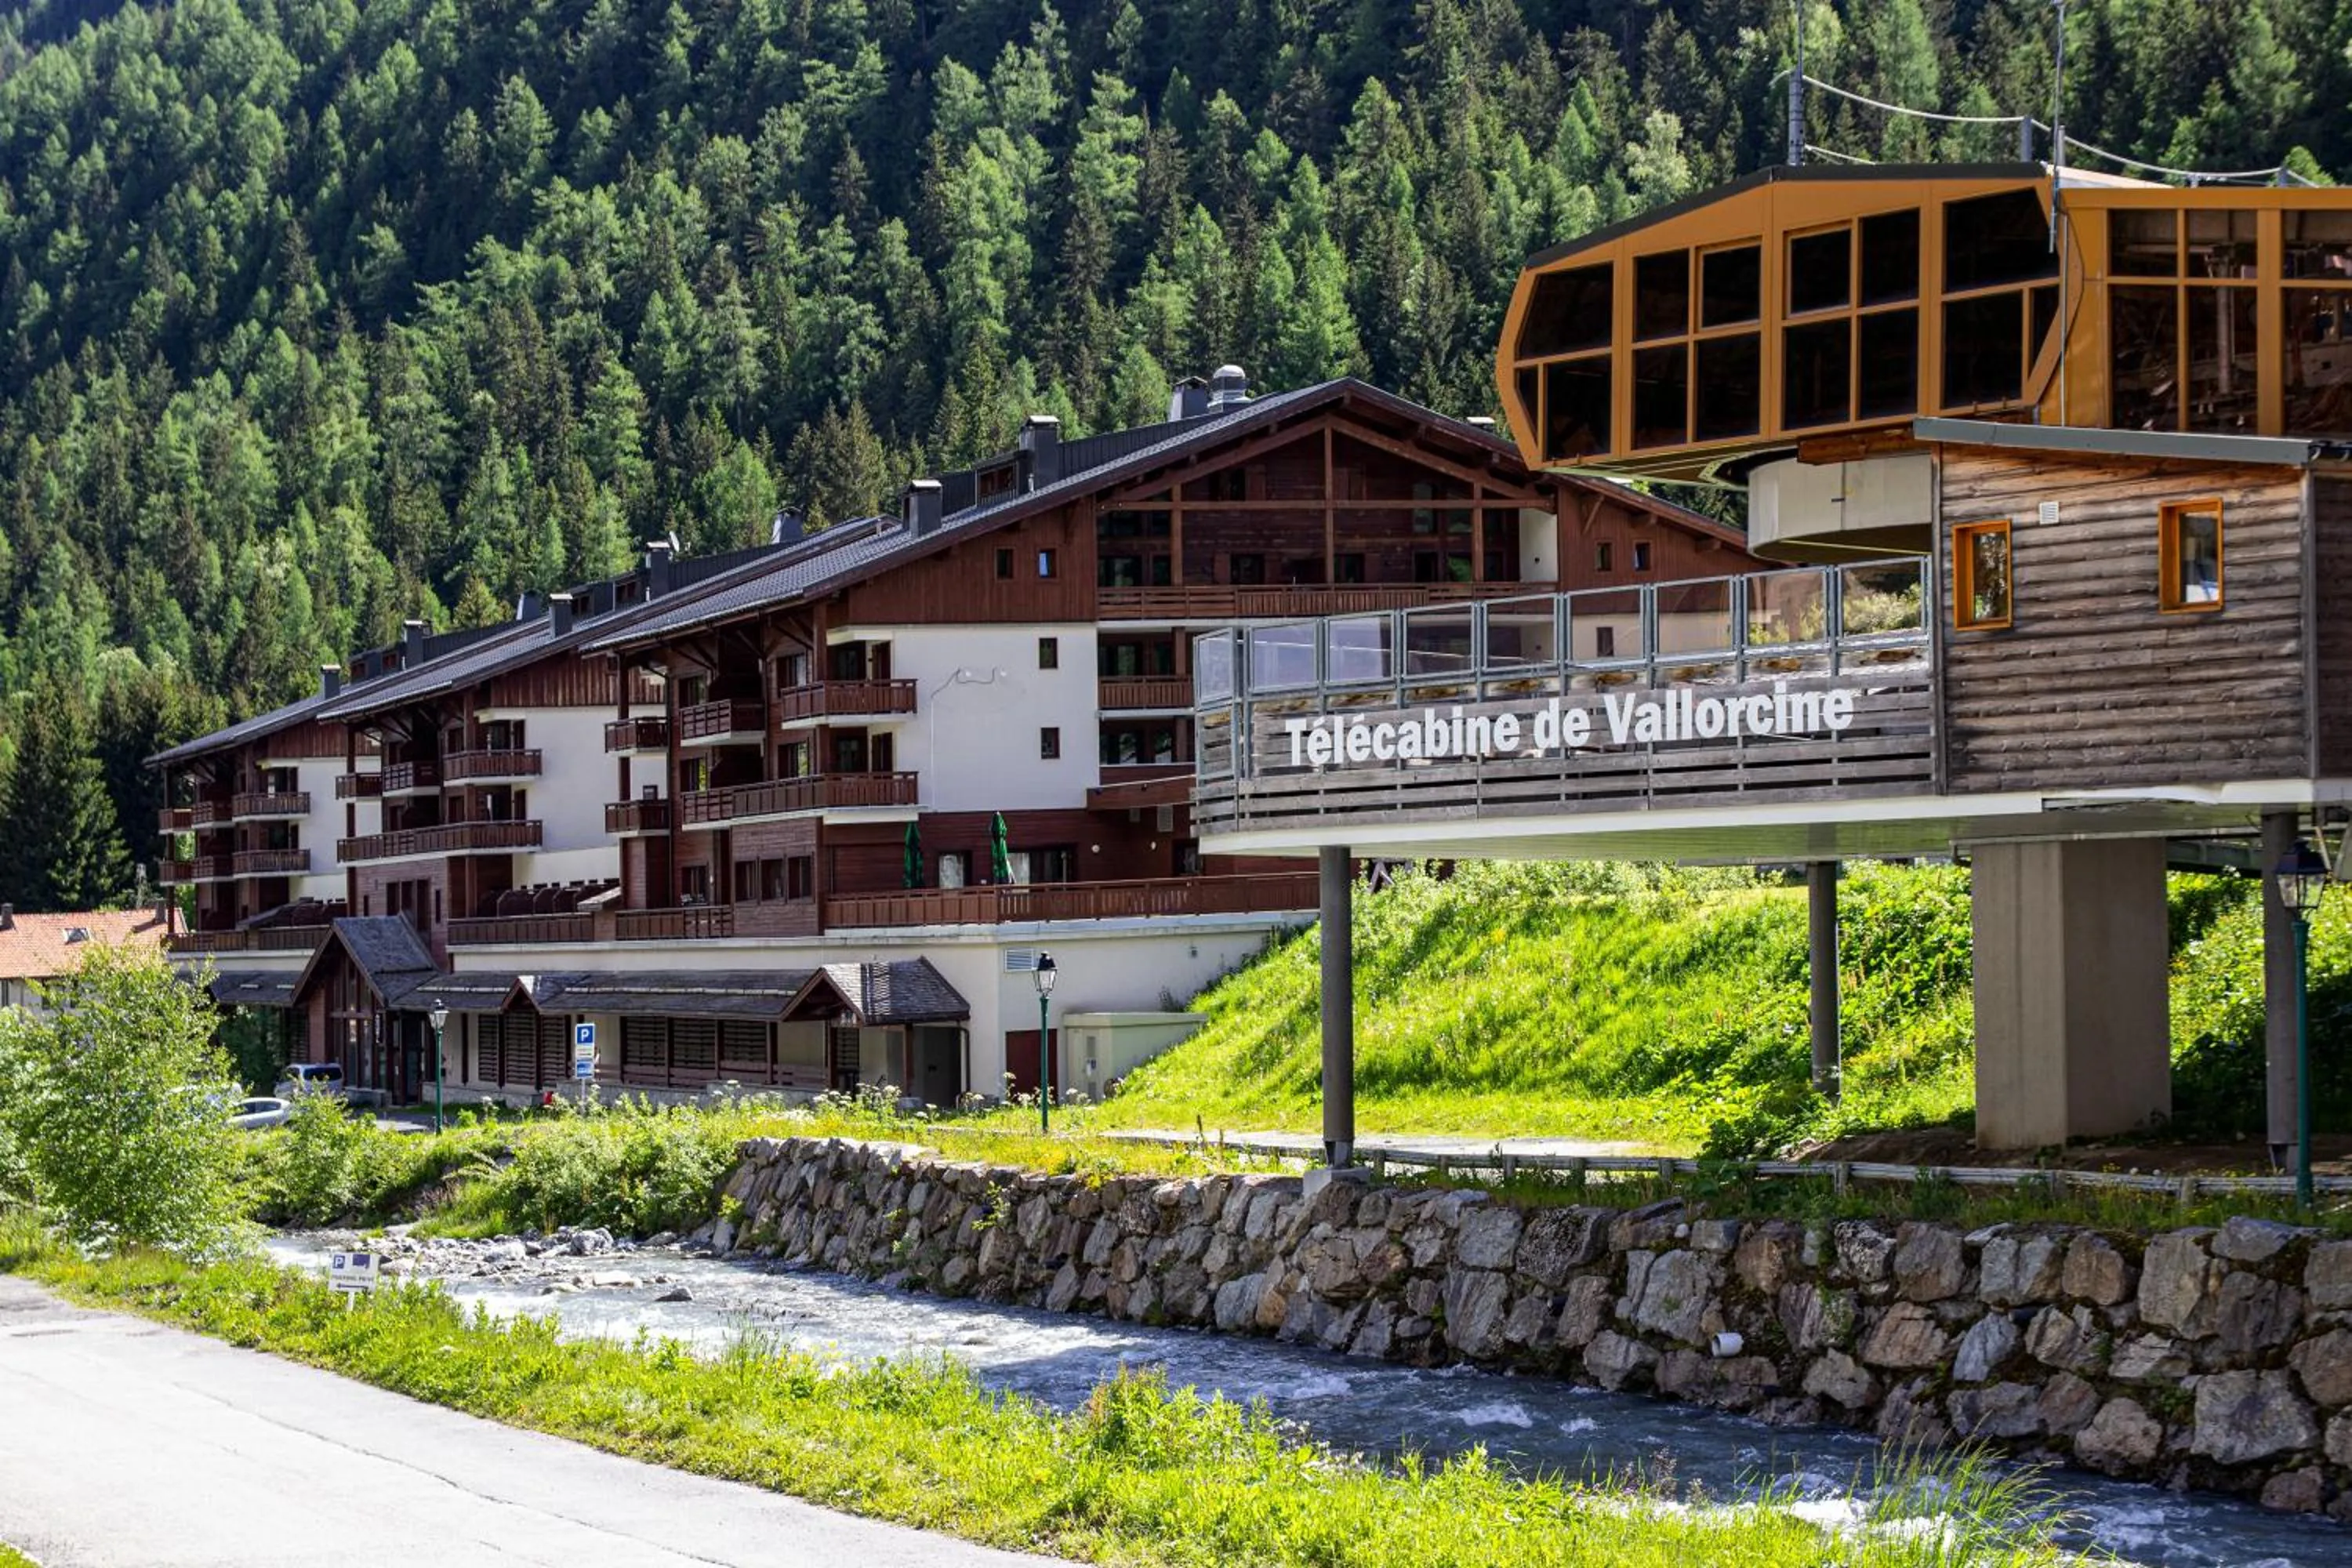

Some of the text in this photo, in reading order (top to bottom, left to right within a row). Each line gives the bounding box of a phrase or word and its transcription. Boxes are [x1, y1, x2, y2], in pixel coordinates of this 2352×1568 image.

[1285, 681, 1853, 766] Télécabine de Vallorcine
[581, 1029, 590, 1042] P
[335, 1257, 344, 1268] P
